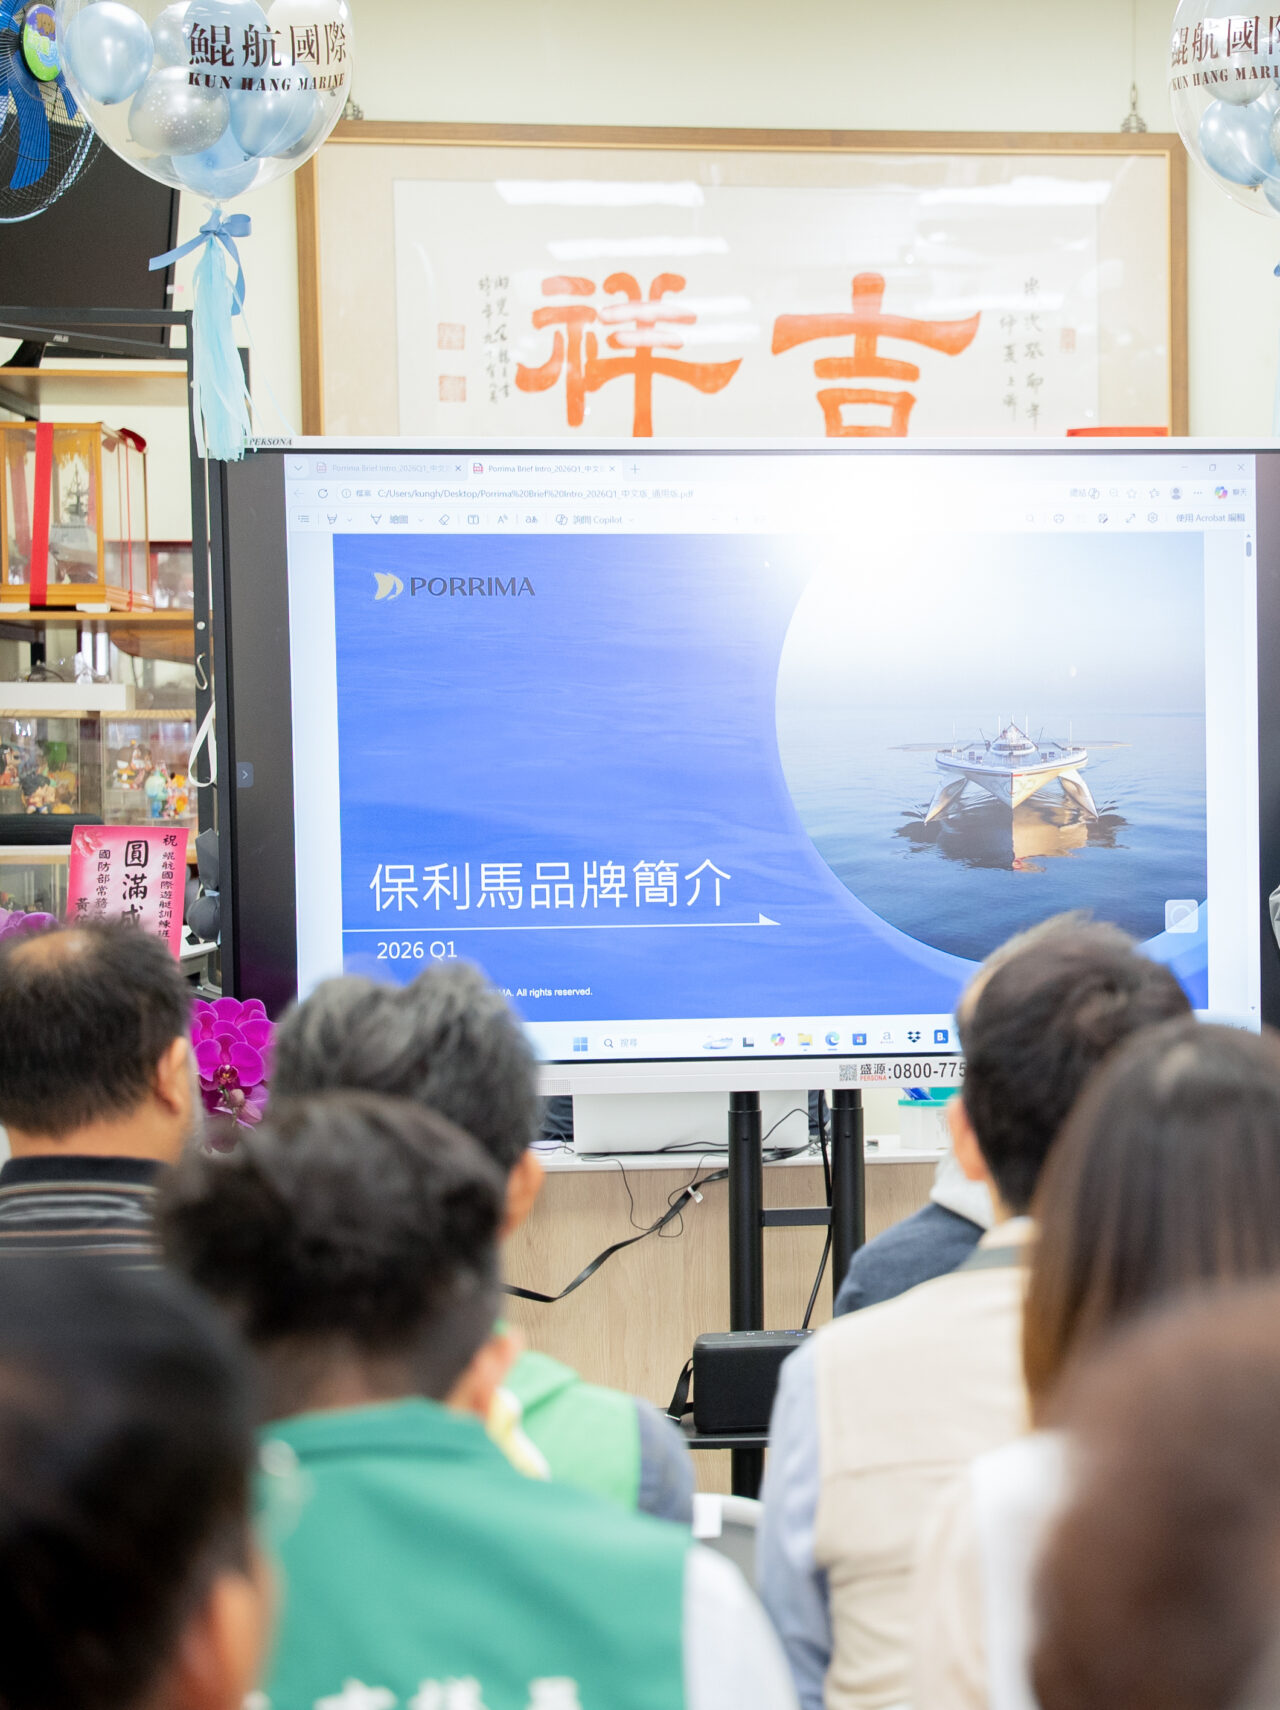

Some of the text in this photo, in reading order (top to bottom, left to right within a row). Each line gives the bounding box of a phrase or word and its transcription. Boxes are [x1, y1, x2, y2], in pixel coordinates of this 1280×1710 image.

[188, 21, 347, 67] 鯤航國際
[188, 72, 345, 91] KUN HANG MARINE
[1172, 76, 1189, 91] KUN
[1193, 69, 1228, 87] HANG
[249, 437, 293, 446] PERSONA
[593, 515, 622, 526] Copilot
[1195, 514, 1226, 523] Acrobat
[410, 576, 536, 598] PORRIMA
[158, 834, 178, 945] 祝 鯤航國際遊艇訓練班
[368, 858, 732, 912] 保利馬品牌簡介
[377, 939, 458, 961] 2026 Q1
[516, 988, 528, 997] All
[529, 988, 552, 998] rights
[554, 987, 593, 997] reserved.
[860, 1074, 888, 1082] PERSONA
